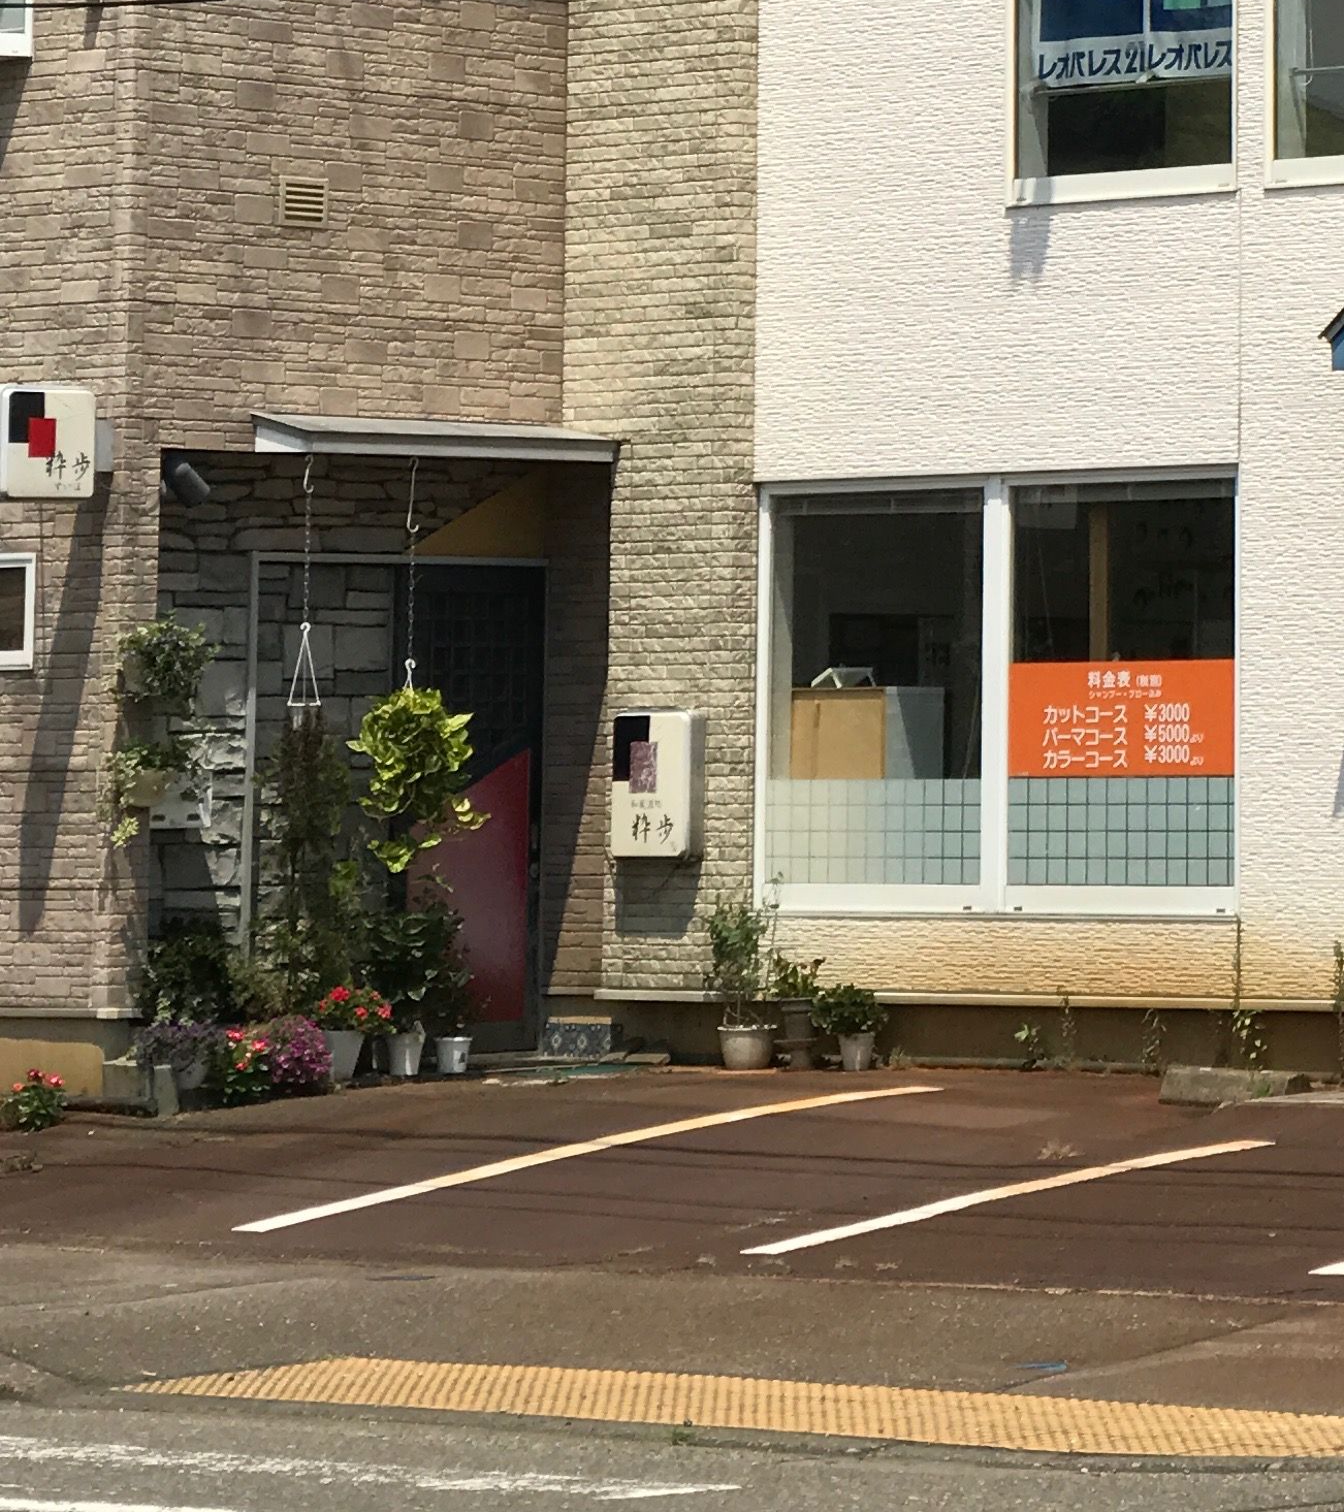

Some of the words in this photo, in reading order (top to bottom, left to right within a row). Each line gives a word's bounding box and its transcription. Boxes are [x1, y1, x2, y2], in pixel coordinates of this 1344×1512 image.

[1038, 44, 1146, 81] レオパレス21
[1087, 670, 1131, 689] 料金表
[1042, 704, 1128, 725] カットコース
[1143, 703, 1190, 723] ¥3000
[1042, 749, 1128, 769] カラーコース
